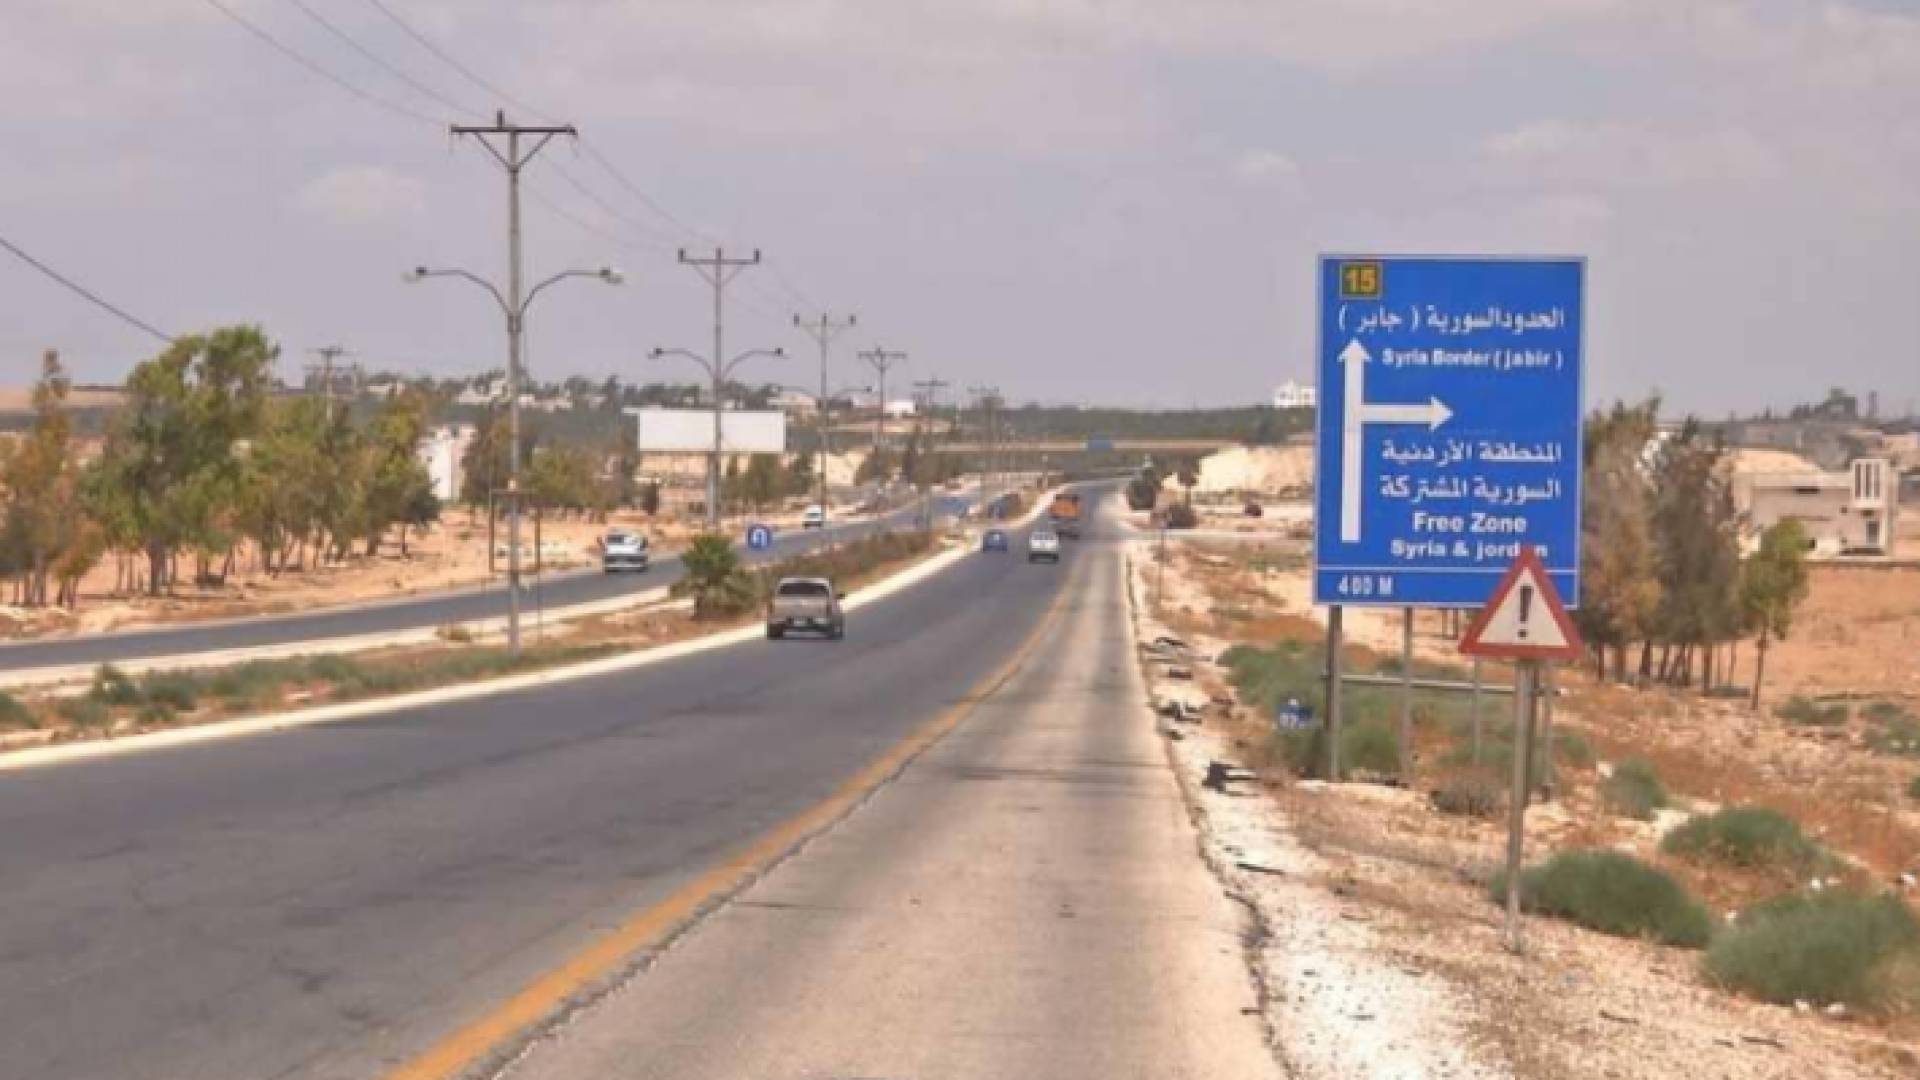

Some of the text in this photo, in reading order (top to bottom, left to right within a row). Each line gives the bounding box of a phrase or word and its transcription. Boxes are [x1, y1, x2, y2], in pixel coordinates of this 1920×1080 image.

[1346, 267, 1377, 292] 15
[1382, 348, 1428, 369] Syria
[1433, 348, 1489, 366] Border
[1412, 511, 1527, 533] Free Zone
[1391, 540, 1548, 561] Syria & jordn
[1379, 575, 1393, 595] M
